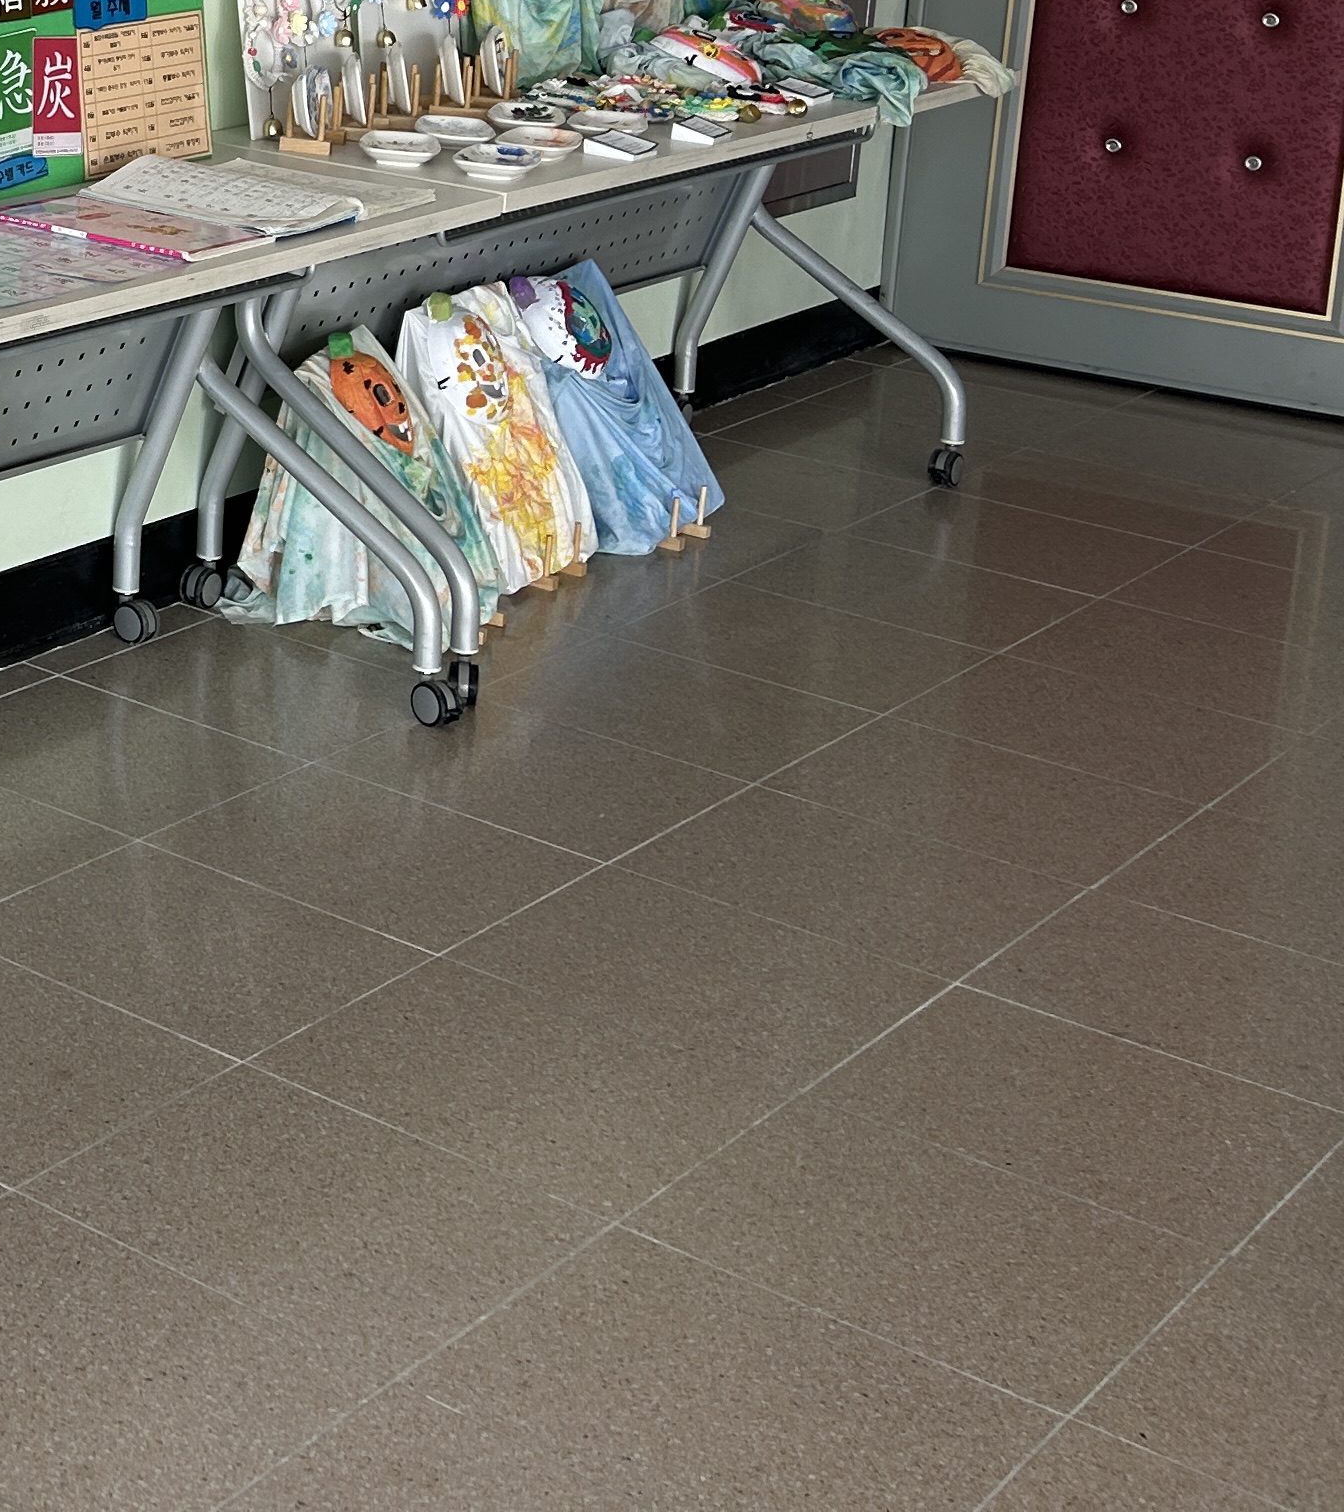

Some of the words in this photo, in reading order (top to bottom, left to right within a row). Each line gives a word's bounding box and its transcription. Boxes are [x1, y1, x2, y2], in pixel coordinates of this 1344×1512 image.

[90, 0, 101, 20] 월
[37, 52, 75, 119] 炭
[16, 161, 34, 176] 카드
